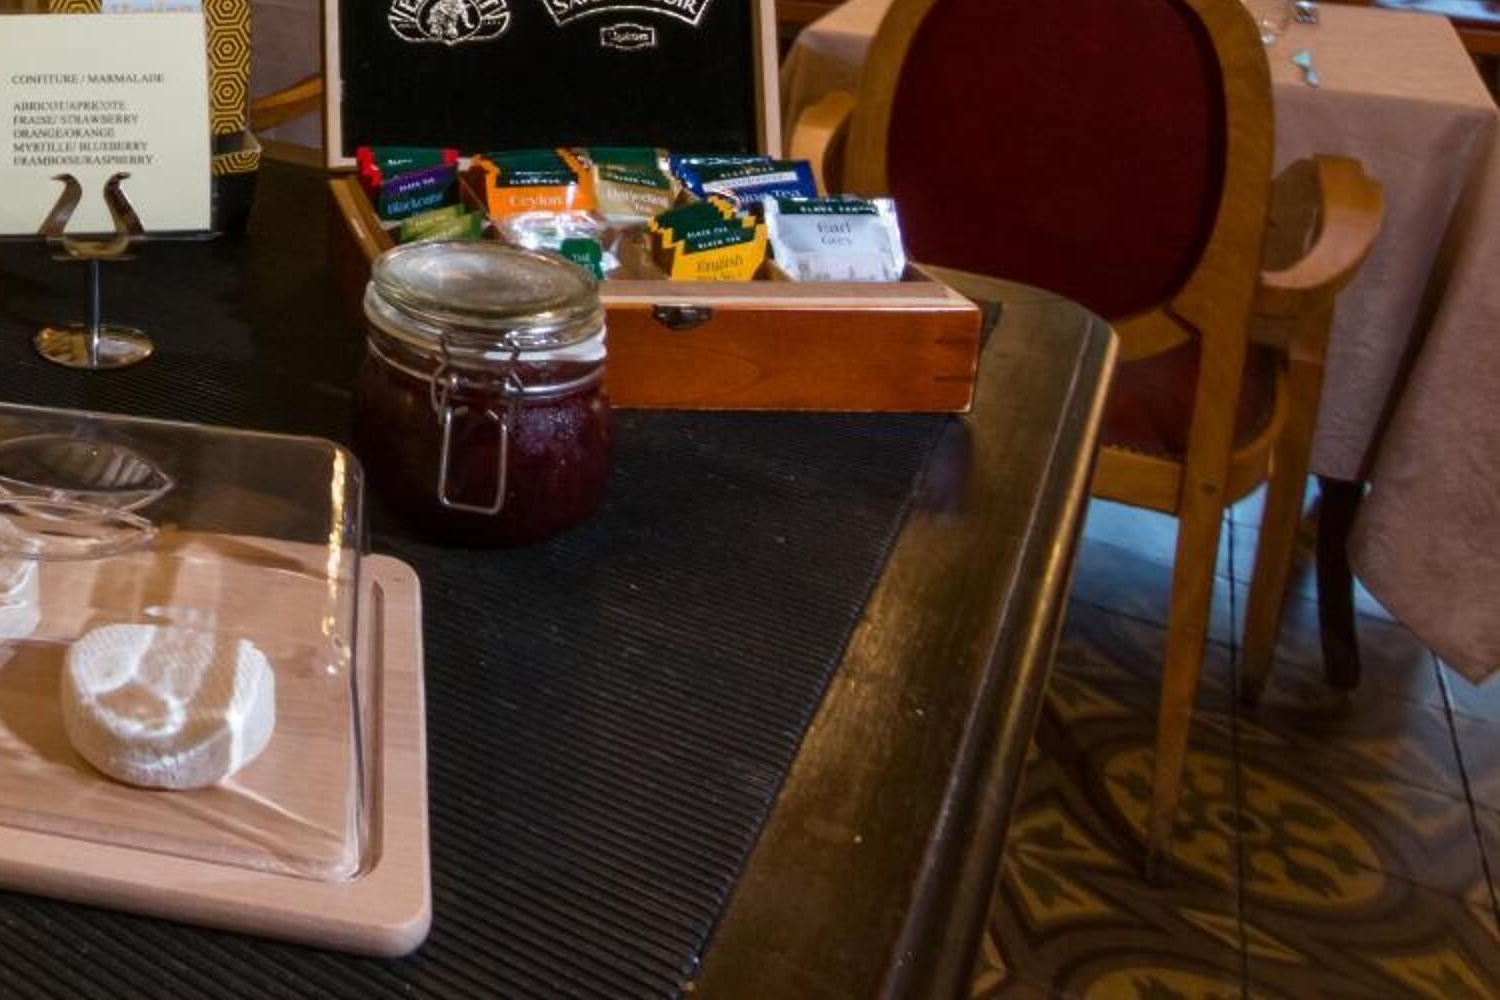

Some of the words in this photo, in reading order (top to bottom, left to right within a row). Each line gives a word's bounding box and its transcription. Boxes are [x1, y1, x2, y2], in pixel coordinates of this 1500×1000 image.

[11, 74, 79, 85] CONFITURE
[87, 73, 165, 84] MARMALADE
[60, 113, 140, 125] STRAWBERRY
[79, 141, 149, 152] BLUEBERRY
